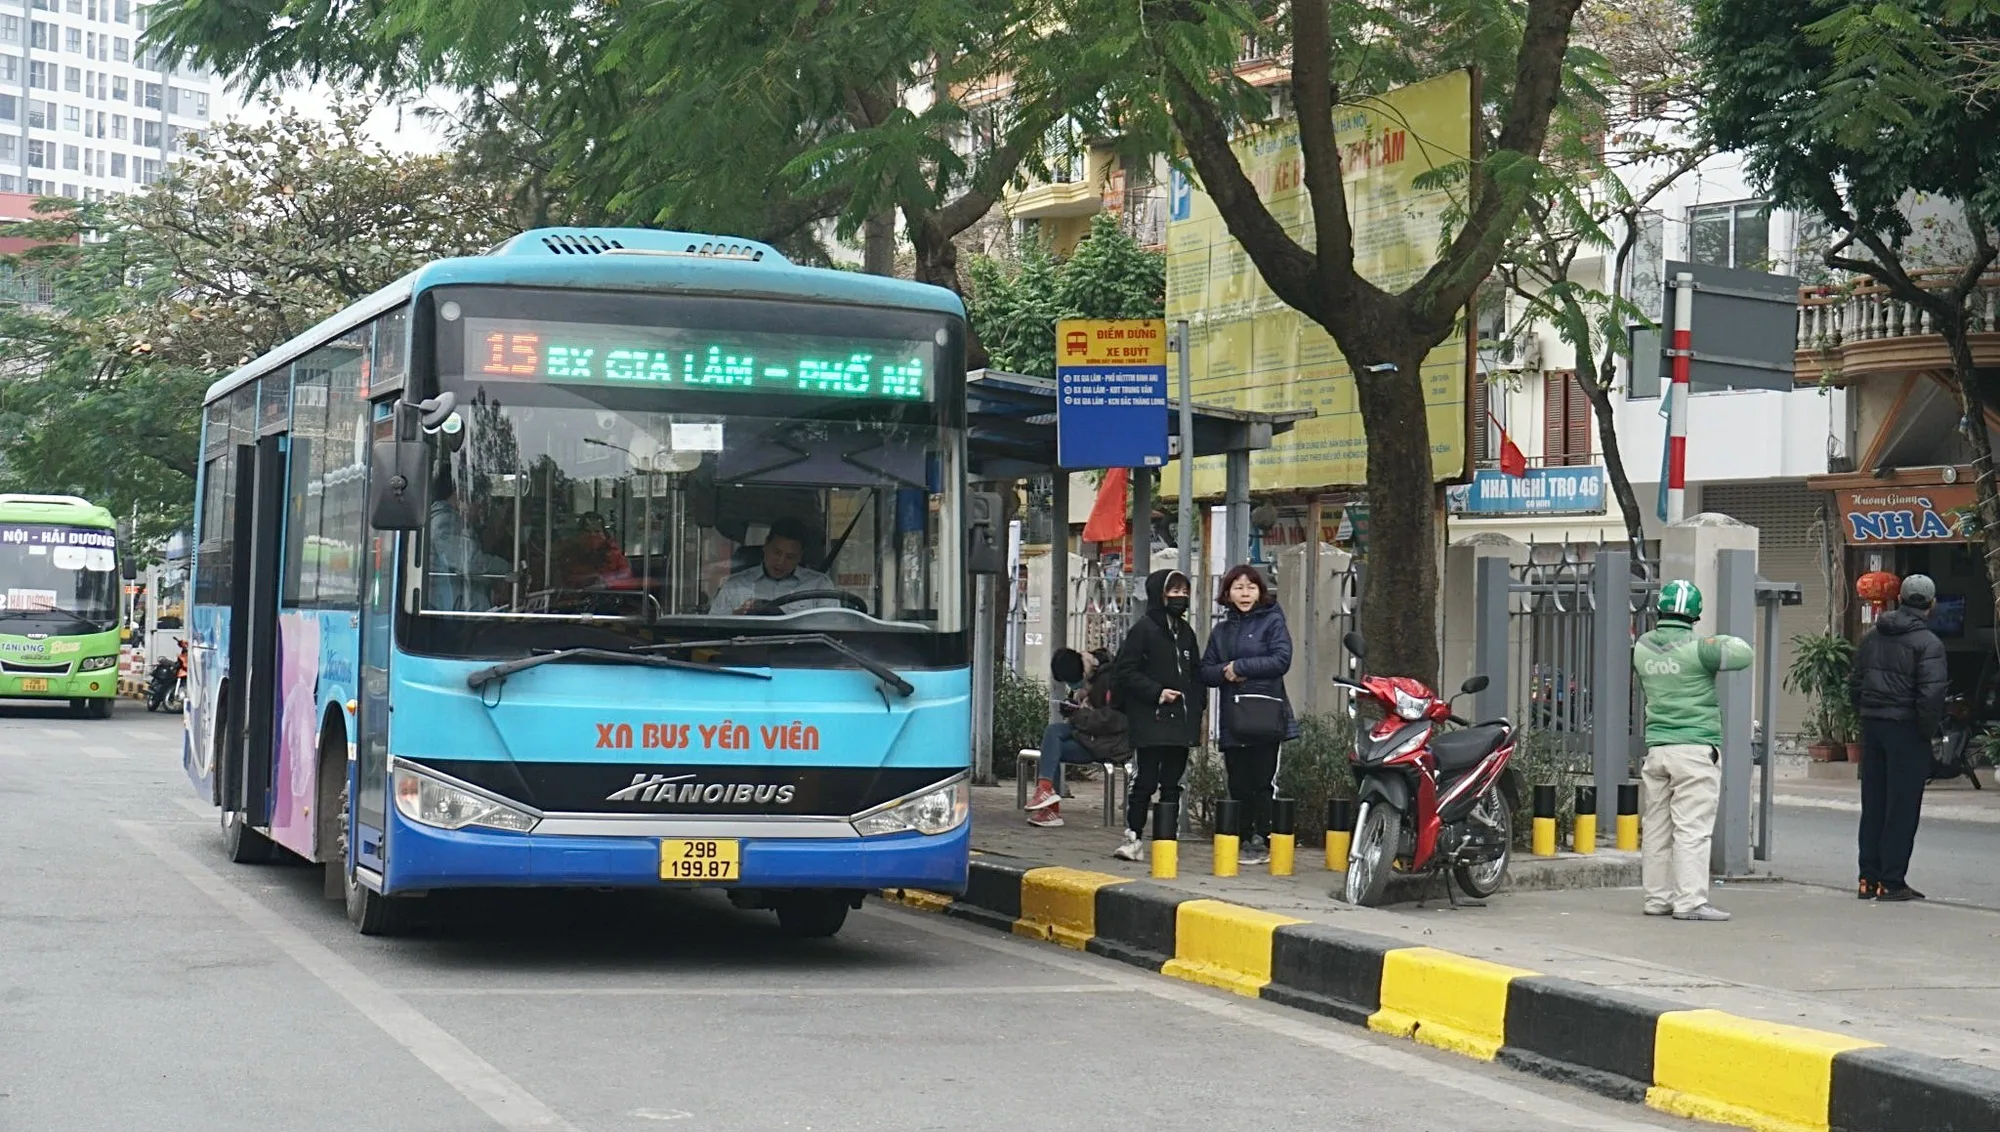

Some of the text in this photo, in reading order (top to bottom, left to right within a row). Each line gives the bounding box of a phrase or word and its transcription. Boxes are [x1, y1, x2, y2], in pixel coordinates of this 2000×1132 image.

[1106, 347, 1119, 357] XE
[483, 333, 539, 374] 15
[548, 346, 594, 377] BX
[606, 350, 672, 381] GIA
[684, 346, 753, 386] LÂM
[799, 354, 873, 392] PHỐ
[1481, 472, 1599, 501] NHÀ NGHỈ TRỌ 46
[1887, 493, 1919, 506] Giang
[1848, 497, 1953, 540] NHÀ
[3, 529, 28, 545] NỘI
[41, 529, 66, 544] HẢI
[69, 532, 116, 548] DƯƠNG
[1644, 657, 1680, 675] Grab
[596, 719, 820, 751] XN BUS YÊN VIÊN
[606, 773, 796, 804] HANOIBUS
[684, 841, 717, 858] 29B
[671, 860, 731, 878] 199.87
